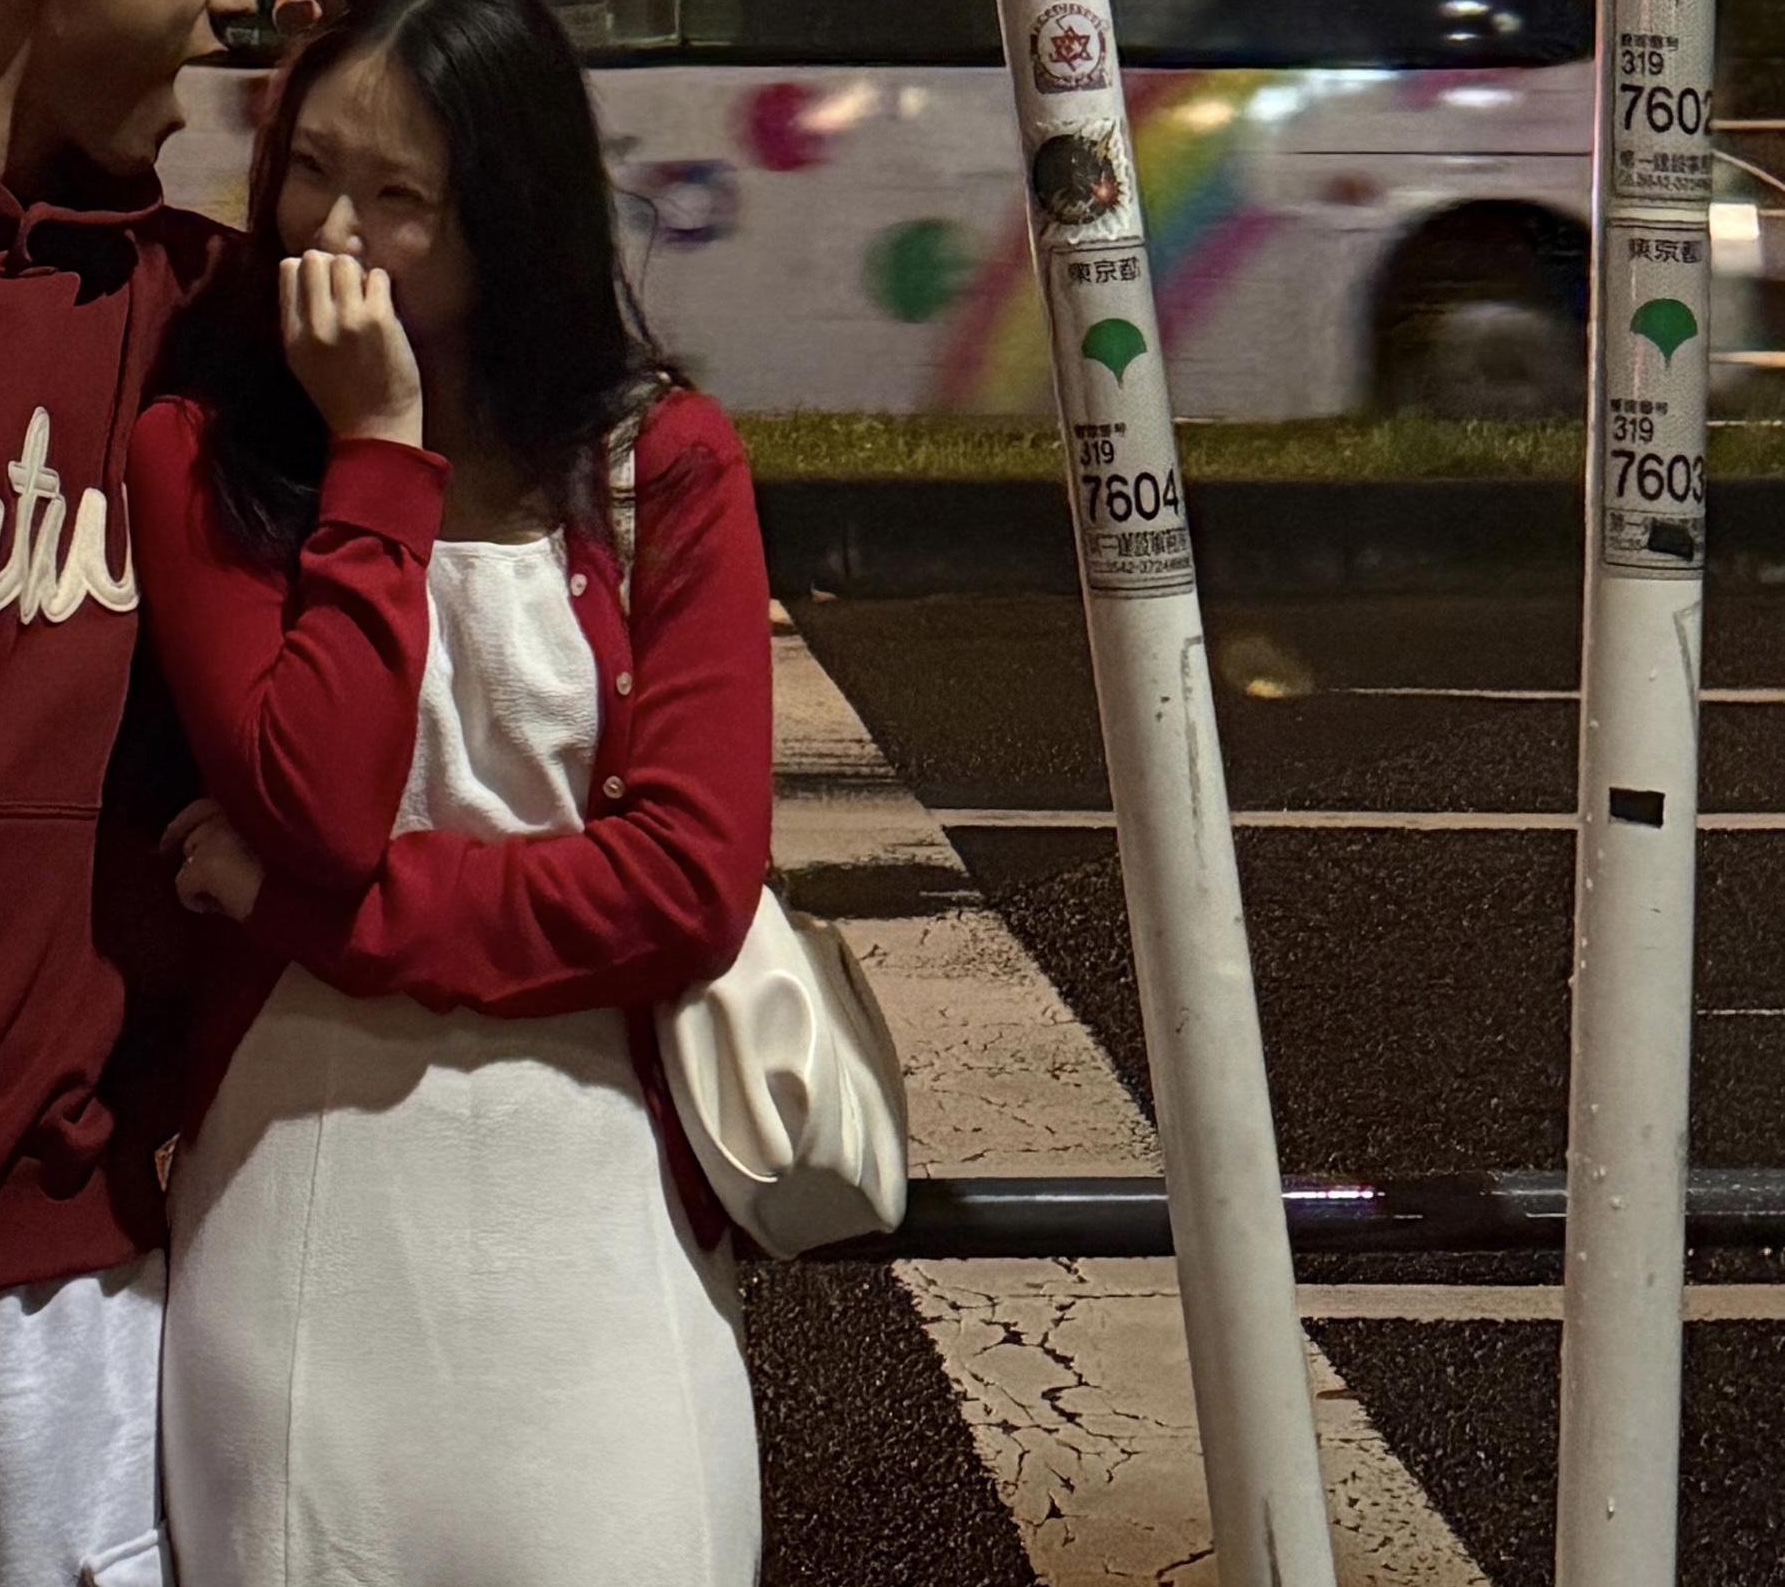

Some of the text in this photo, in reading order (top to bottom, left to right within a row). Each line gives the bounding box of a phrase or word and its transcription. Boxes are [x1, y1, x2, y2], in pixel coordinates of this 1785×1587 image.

[1621, 49, 1665, 76] 319
[1613, 414, 1654, 444] 319
[1080, 439, 1115, 467] 319
[1610, 449, 1705, 504] 7603
[1081, 467, 1180, 523] 7604
